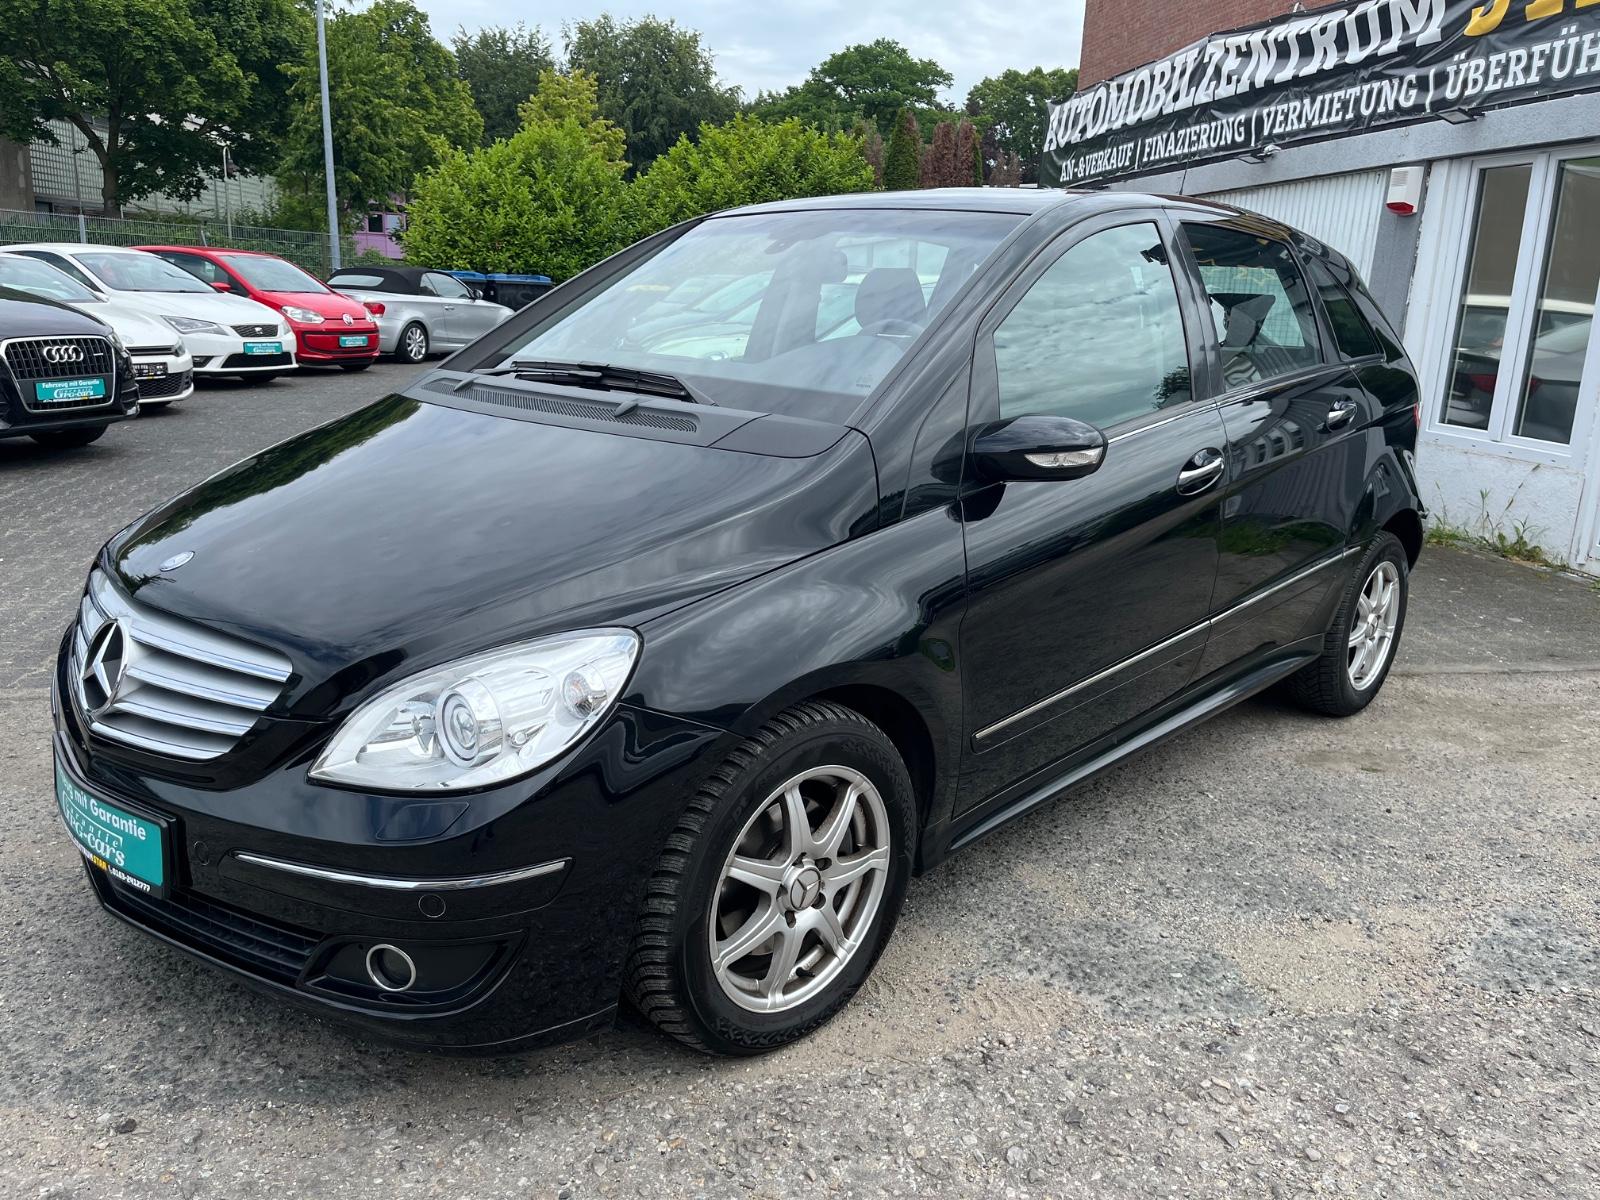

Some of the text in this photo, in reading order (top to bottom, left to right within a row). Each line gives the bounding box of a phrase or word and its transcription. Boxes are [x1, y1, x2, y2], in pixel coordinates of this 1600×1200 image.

[1043, 0, 1444, 152] AUTOMOBILZENTRUM
[1059, 144, 1134, 182] AN-&VERKAUF
[1142, 114, 1245, 162] FINAZIERUNG
[1262, 74, 1419, 136] VERMIETUNG
[74, 790, 88, 810] mit
[90, 798, 147, 841] Garantie
